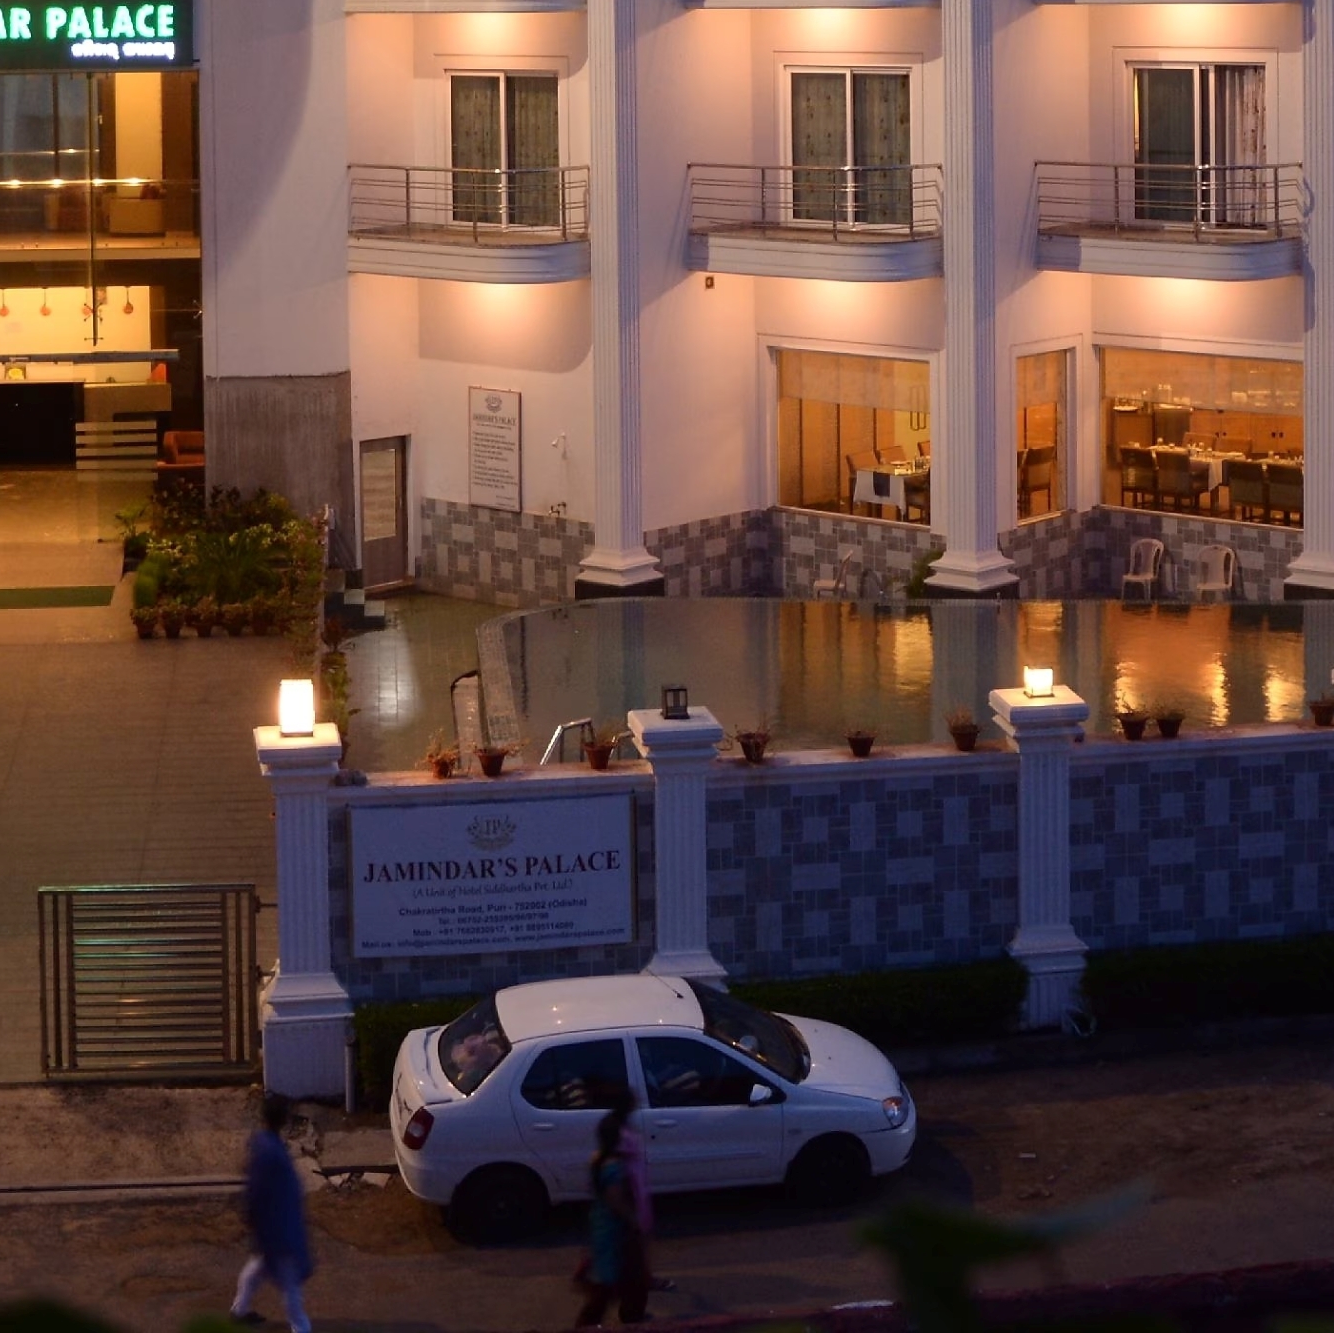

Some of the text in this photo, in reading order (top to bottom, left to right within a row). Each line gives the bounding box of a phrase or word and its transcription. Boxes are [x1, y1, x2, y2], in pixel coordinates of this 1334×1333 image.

[45, 4, 174, 40] PALACE
[364, 850, 621, 883] JAMINDAR'S PALACE
